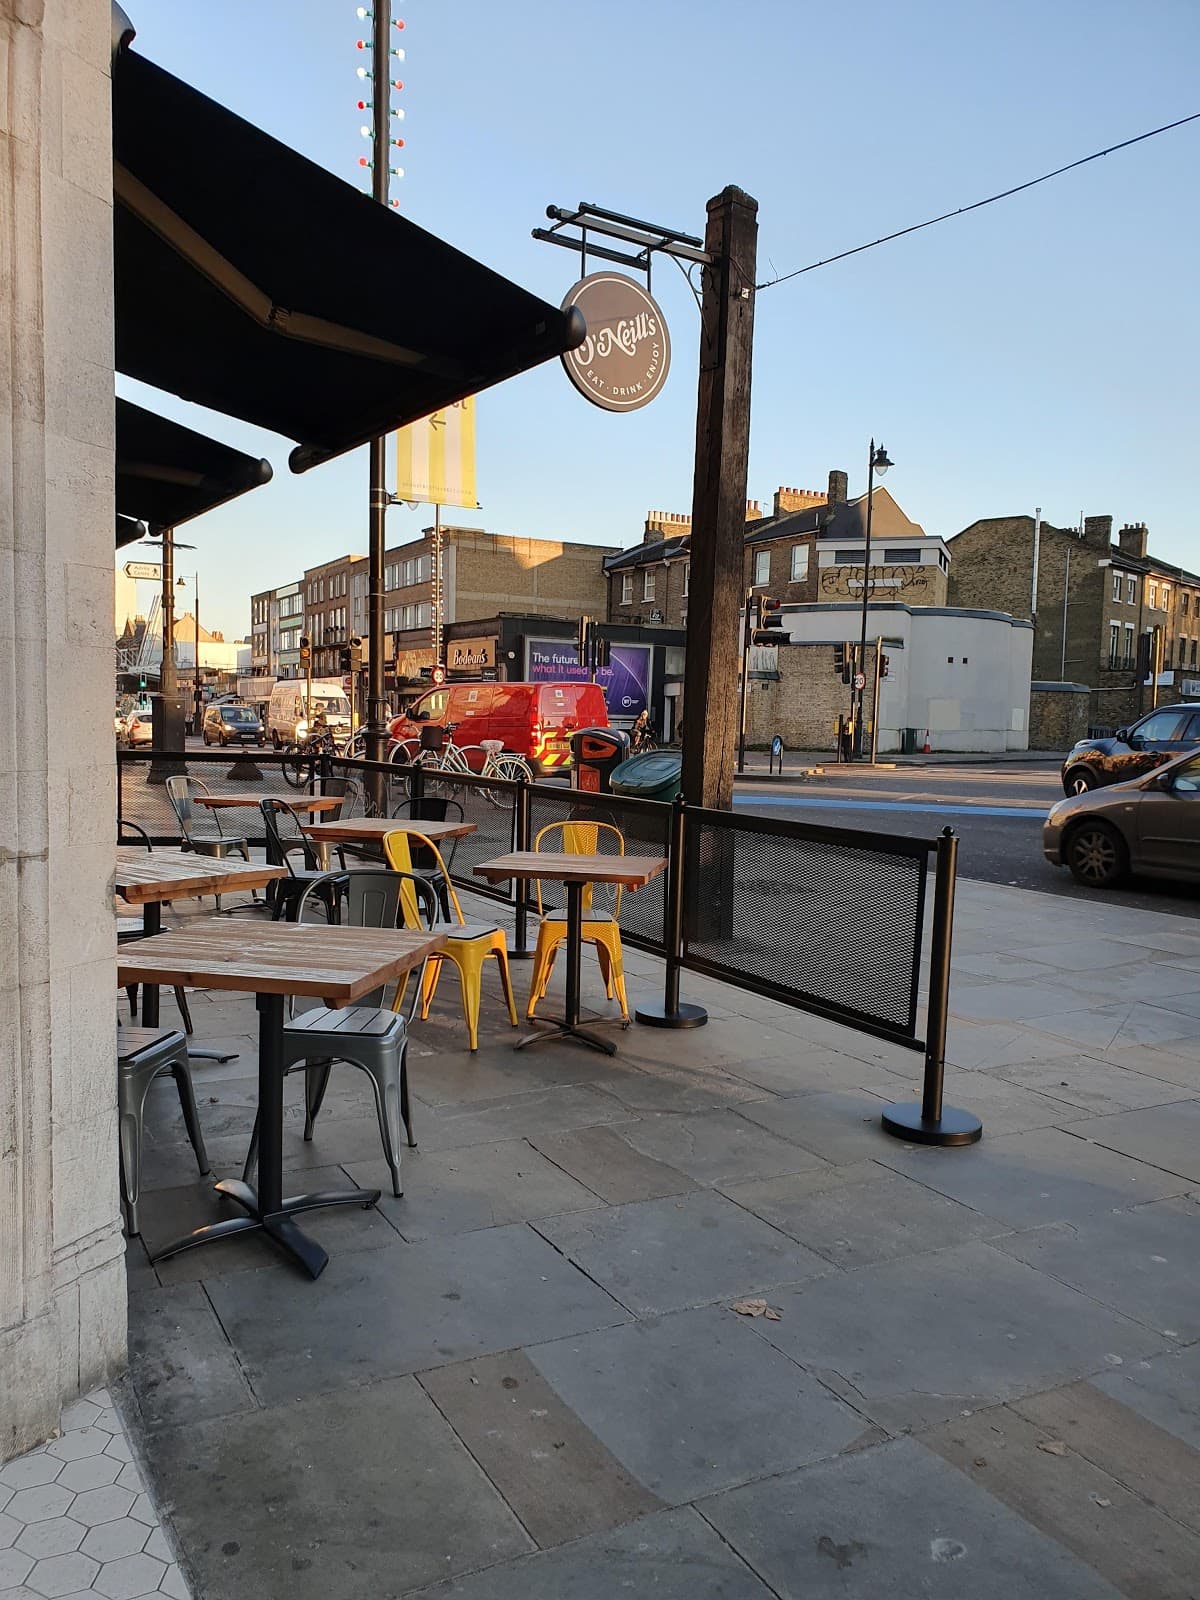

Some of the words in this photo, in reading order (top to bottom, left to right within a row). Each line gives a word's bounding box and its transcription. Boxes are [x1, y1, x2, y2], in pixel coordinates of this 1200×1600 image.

[574, 312, 656, 366] O'Neill's
[586, 369, 605, 388] EAT
[612, 381, 643, 396] DRINK
[646, 341, 660, 379] ENJOY
[453, 648, 487, 665] Bodean's
[533, 652, 549, 663] The
[532, 663, 555, 673] what
[558, 665, 564, 673] it
[566, 666, 588, 675] used
[601, 666, 615, 676] be.
